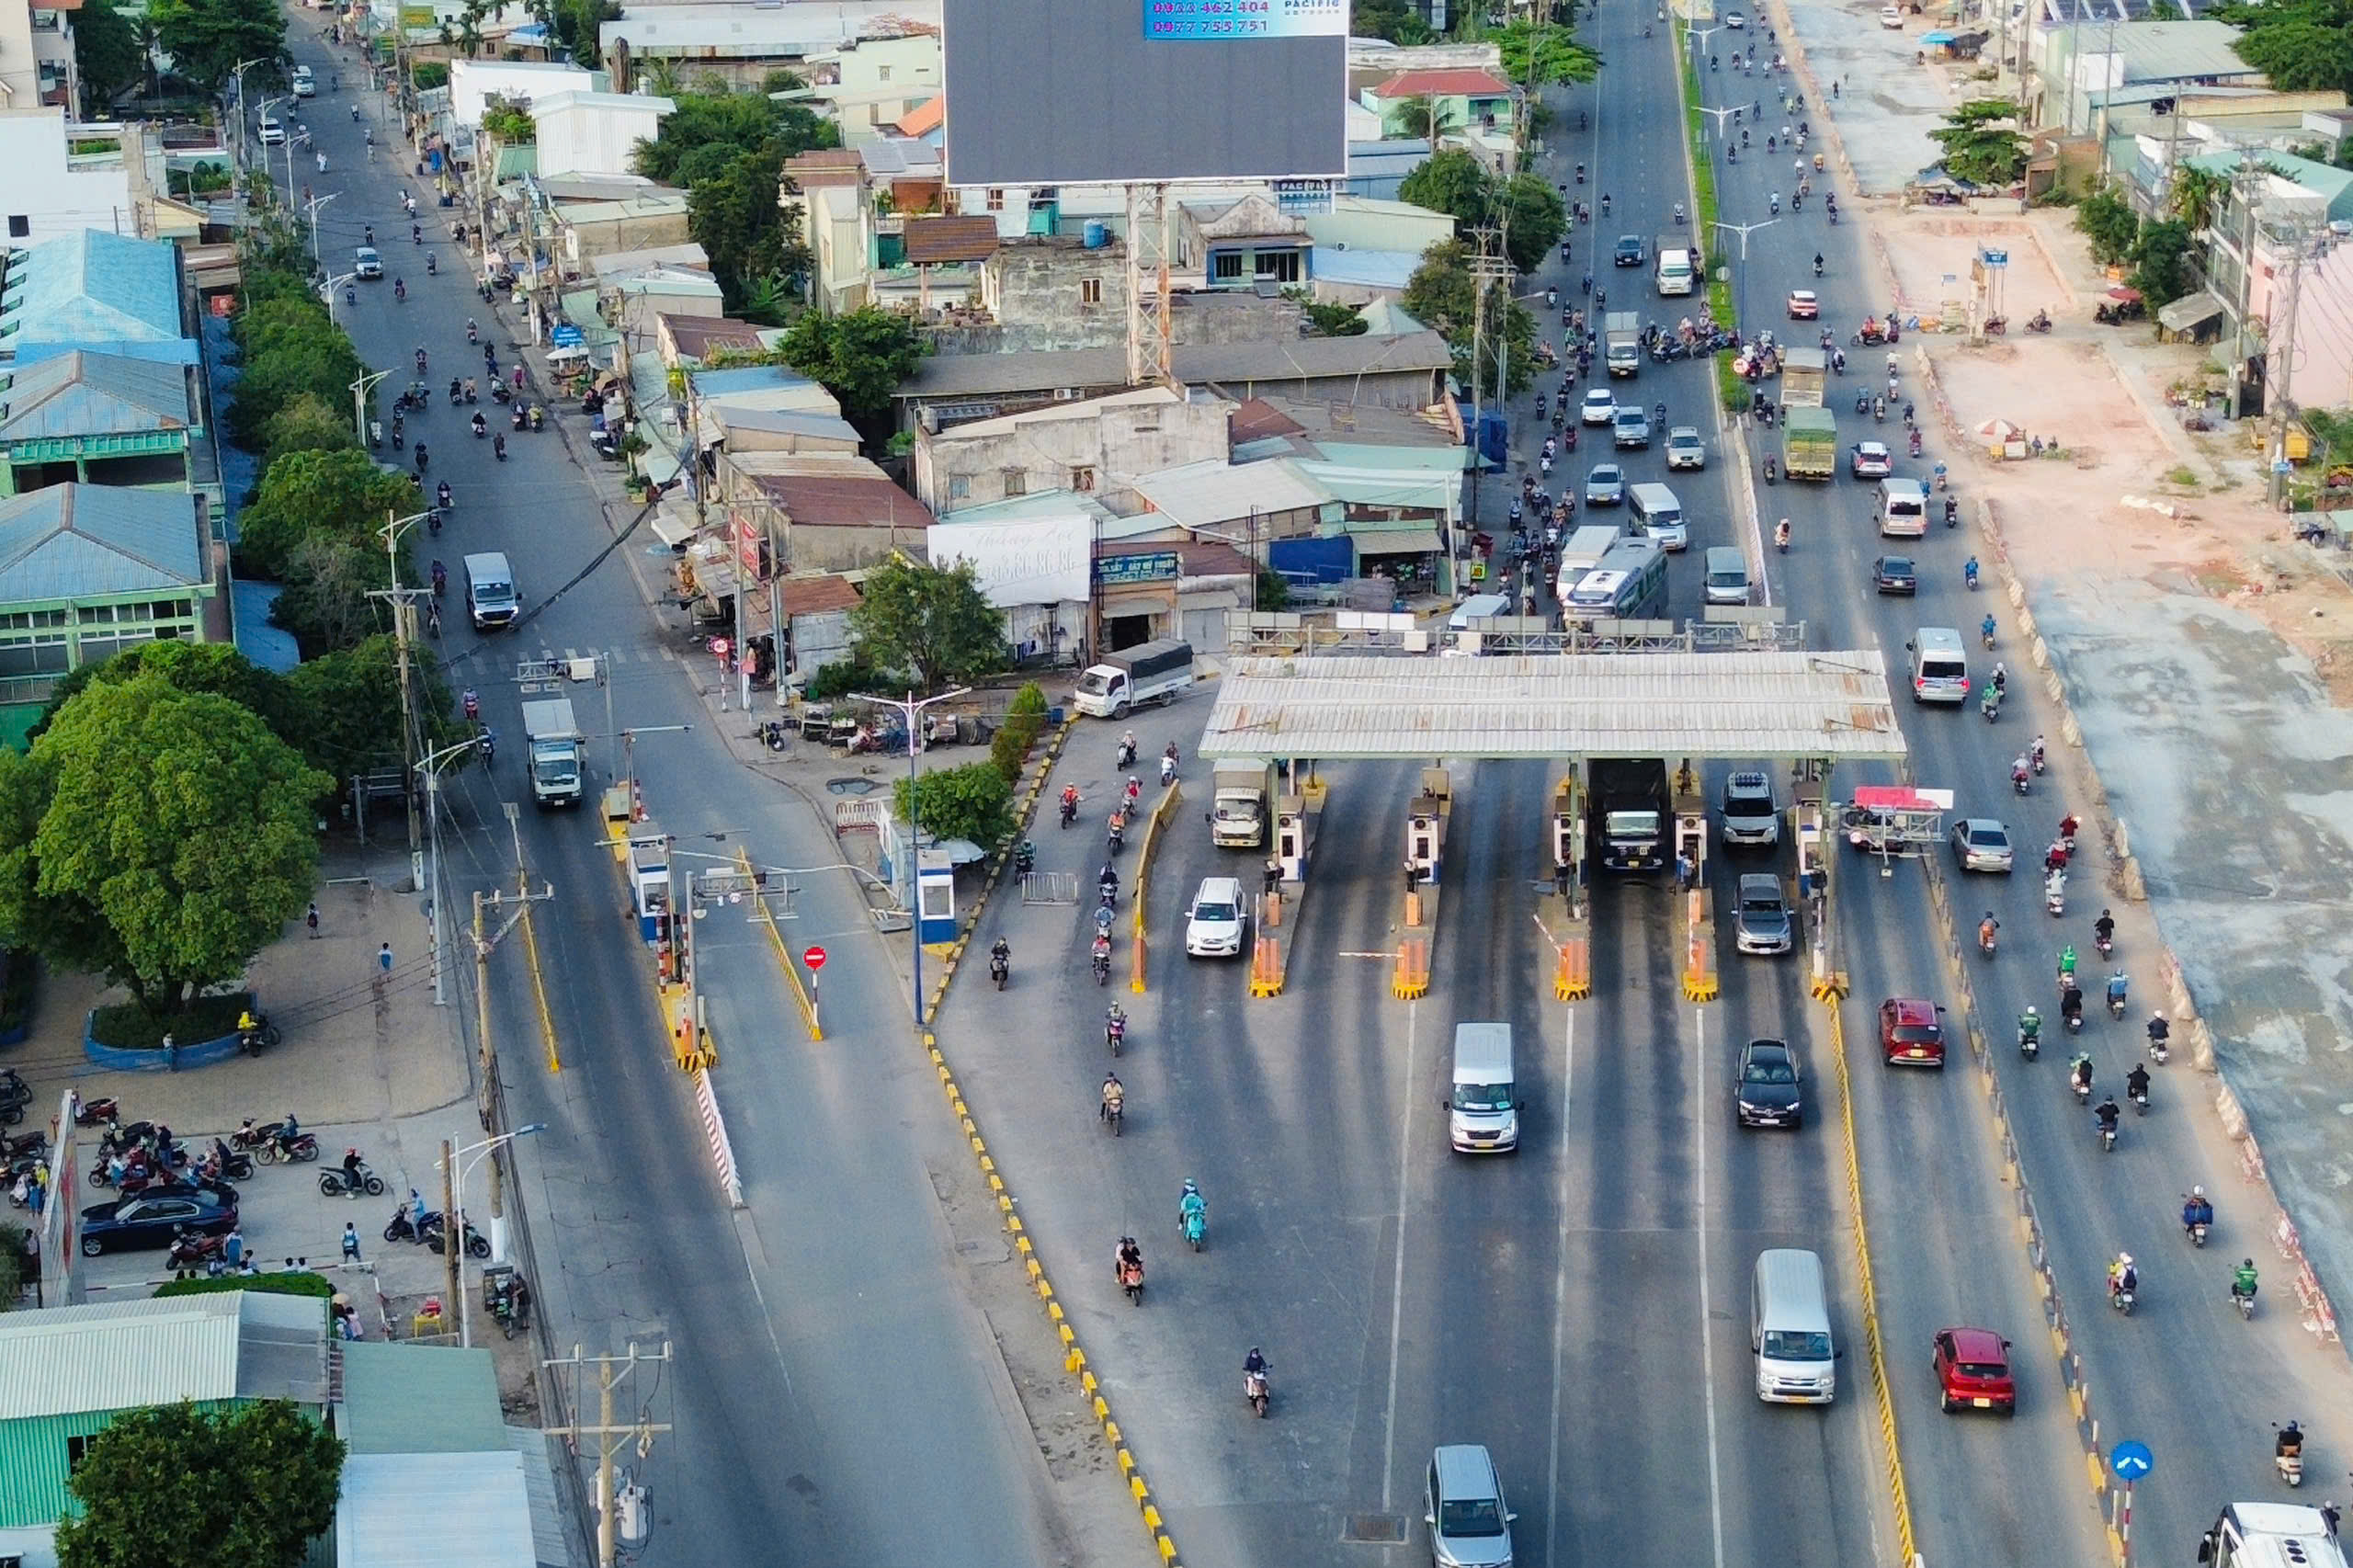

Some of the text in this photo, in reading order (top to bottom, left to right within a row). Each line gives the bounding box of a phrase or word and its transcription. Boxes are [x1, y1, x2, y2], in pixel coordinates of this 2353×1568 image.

[1238, 2, 1269, 13] 404
[1201, 21, 1233, 32] 755
[1238, 20, 1267, 31] 751
